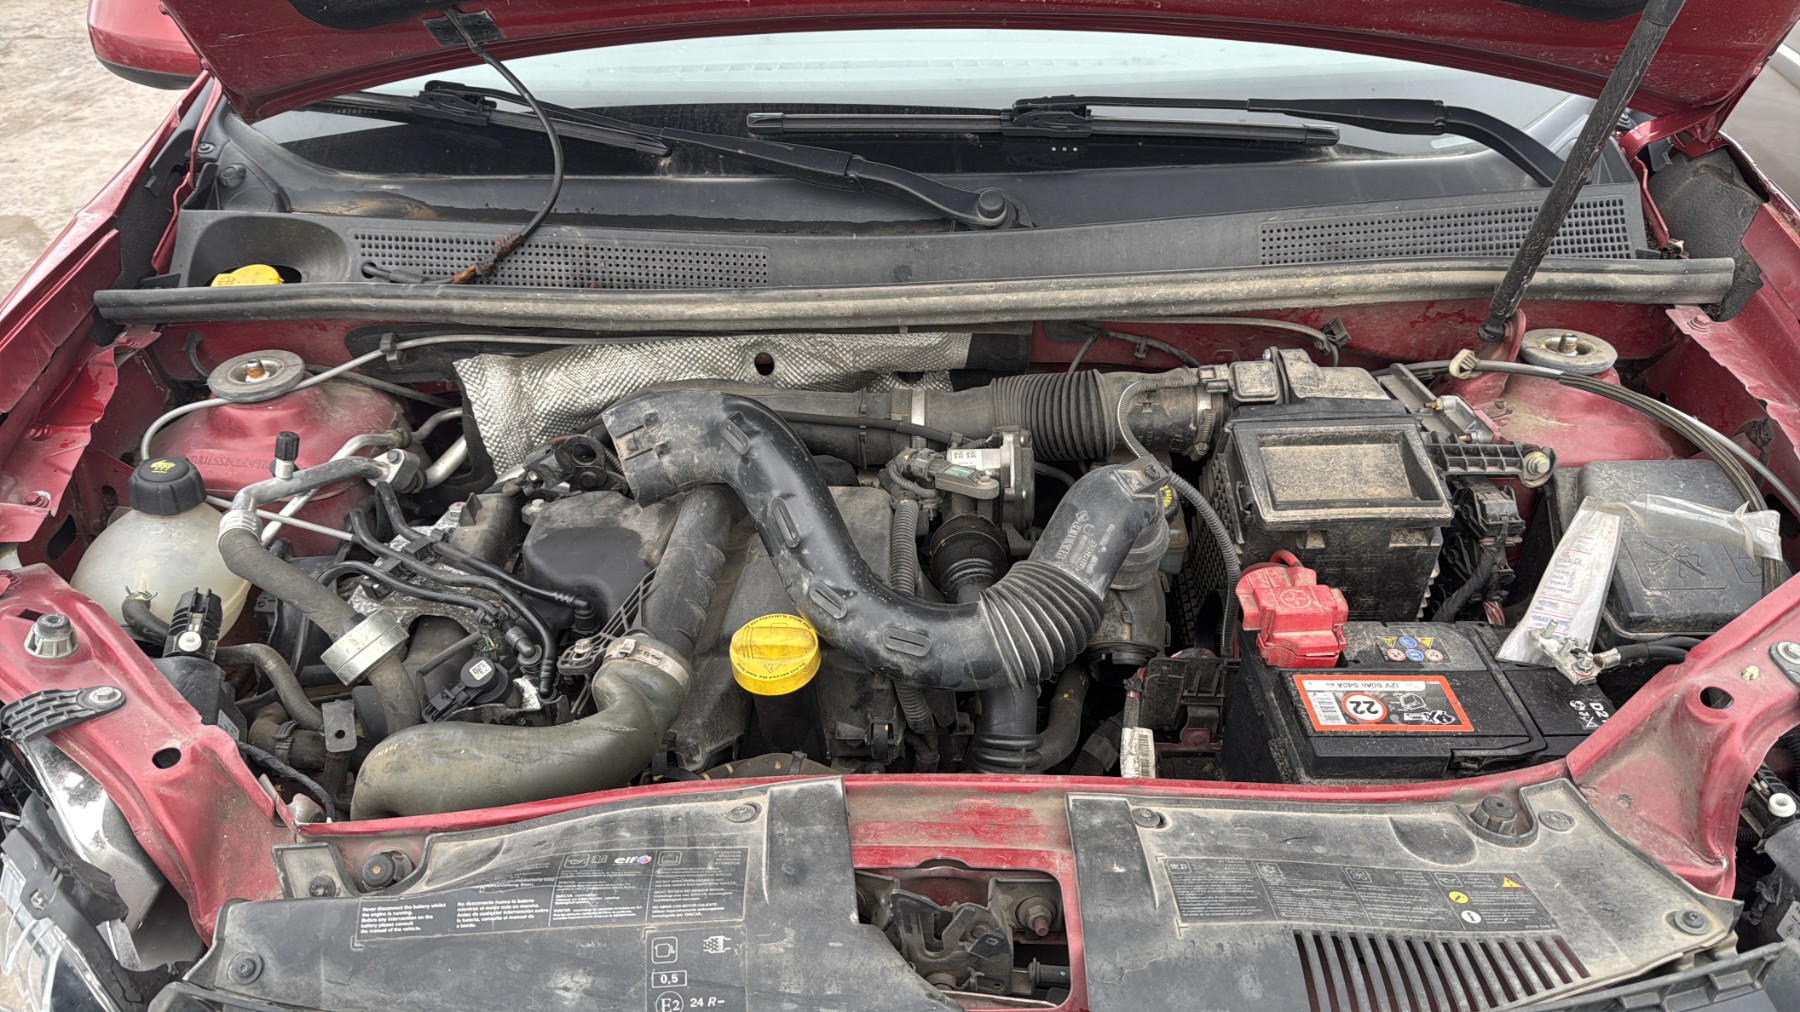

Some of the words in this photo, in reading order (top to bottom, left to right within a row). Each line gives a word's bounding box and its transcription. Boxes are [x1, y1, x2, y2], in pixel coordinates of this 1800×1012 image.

[1055, 521, 1081, 560] RENAULT
[1348, 700, 1379, 714] 22
[660, 974, 678, 984] 0,5
[661, 998, 680, 1012] E2
[690, 998, 704, 1007] 24
